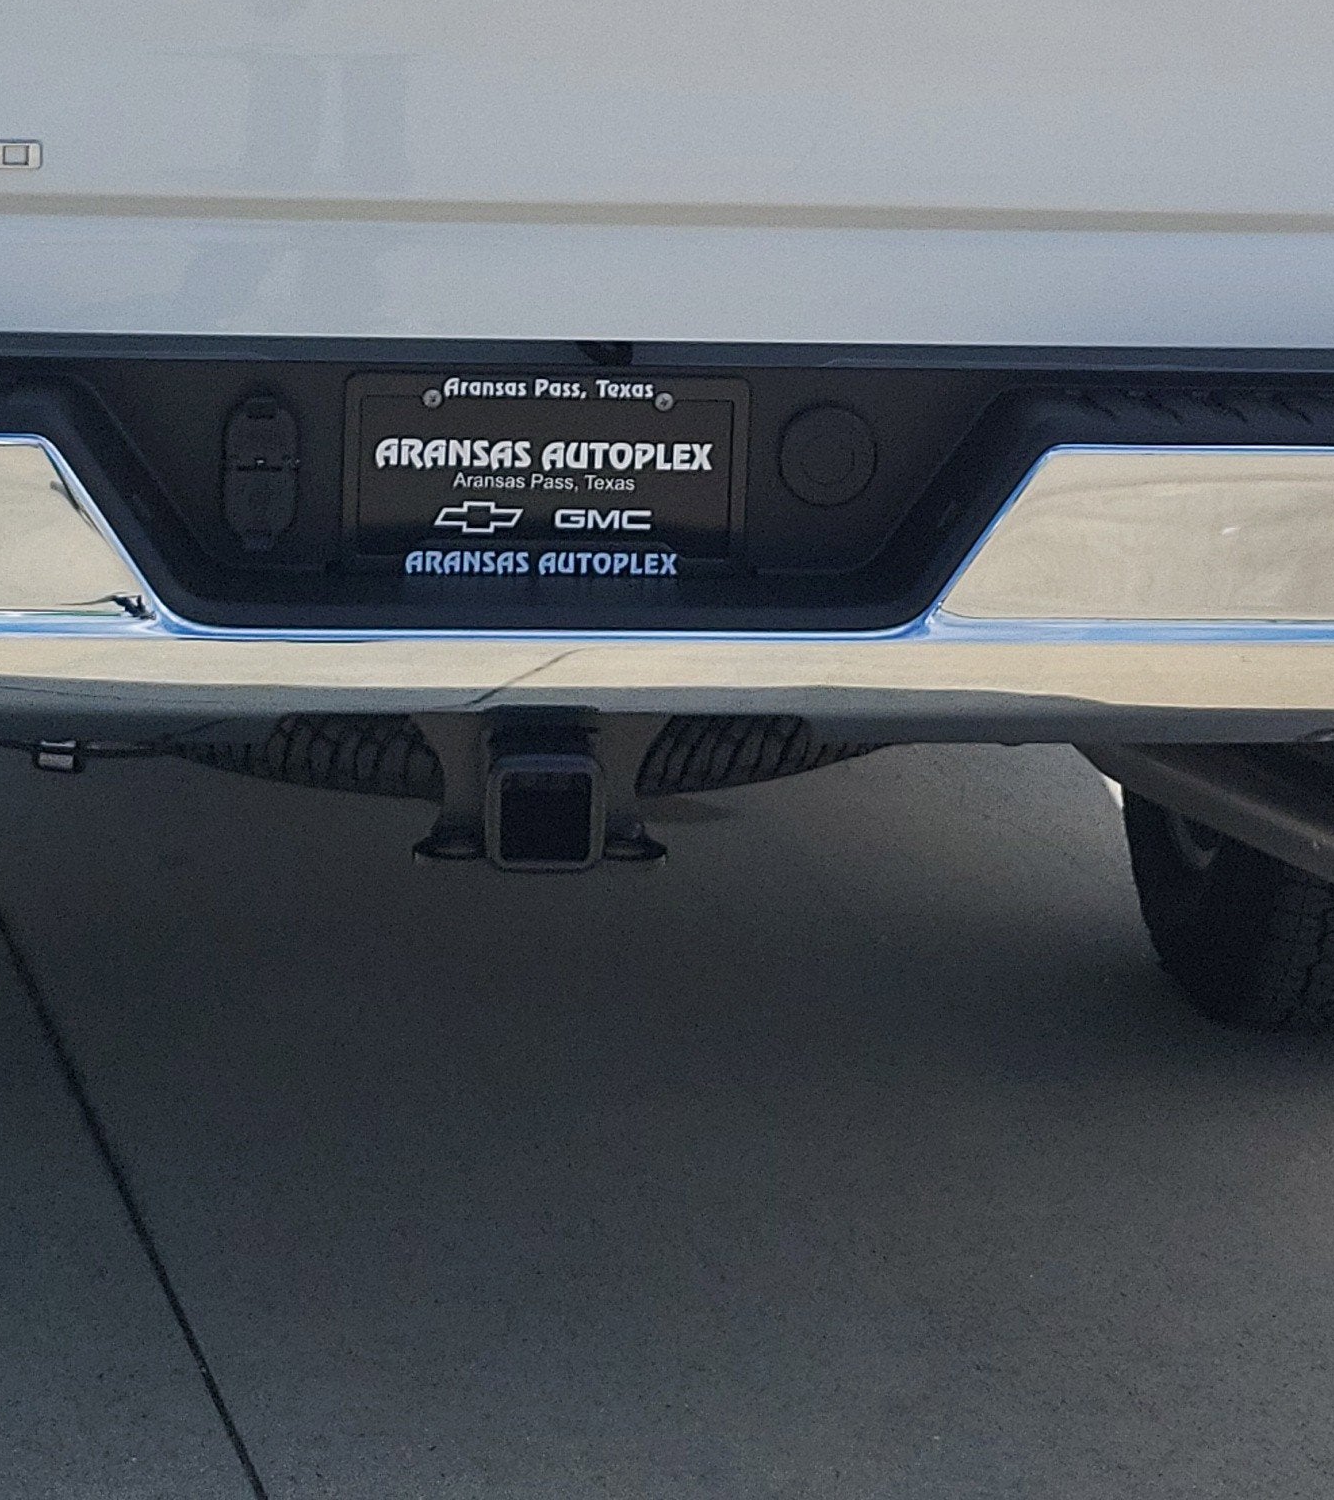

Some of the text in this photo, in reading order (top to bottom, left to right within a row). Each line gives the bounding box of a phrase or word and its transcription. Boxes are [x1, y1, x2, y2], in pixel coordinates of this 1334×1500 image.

[443, 376, 654, 399] Aransas Pass, Texas
[375, 437, 713, 471] ARANSAS AUTOPLEX
[453, 471, 636, 492] Aransas Pass, Texas
[554, 508, 653, 531] GMC
[405, 550, 678, 576] ARANSAS AUTOPLEX
